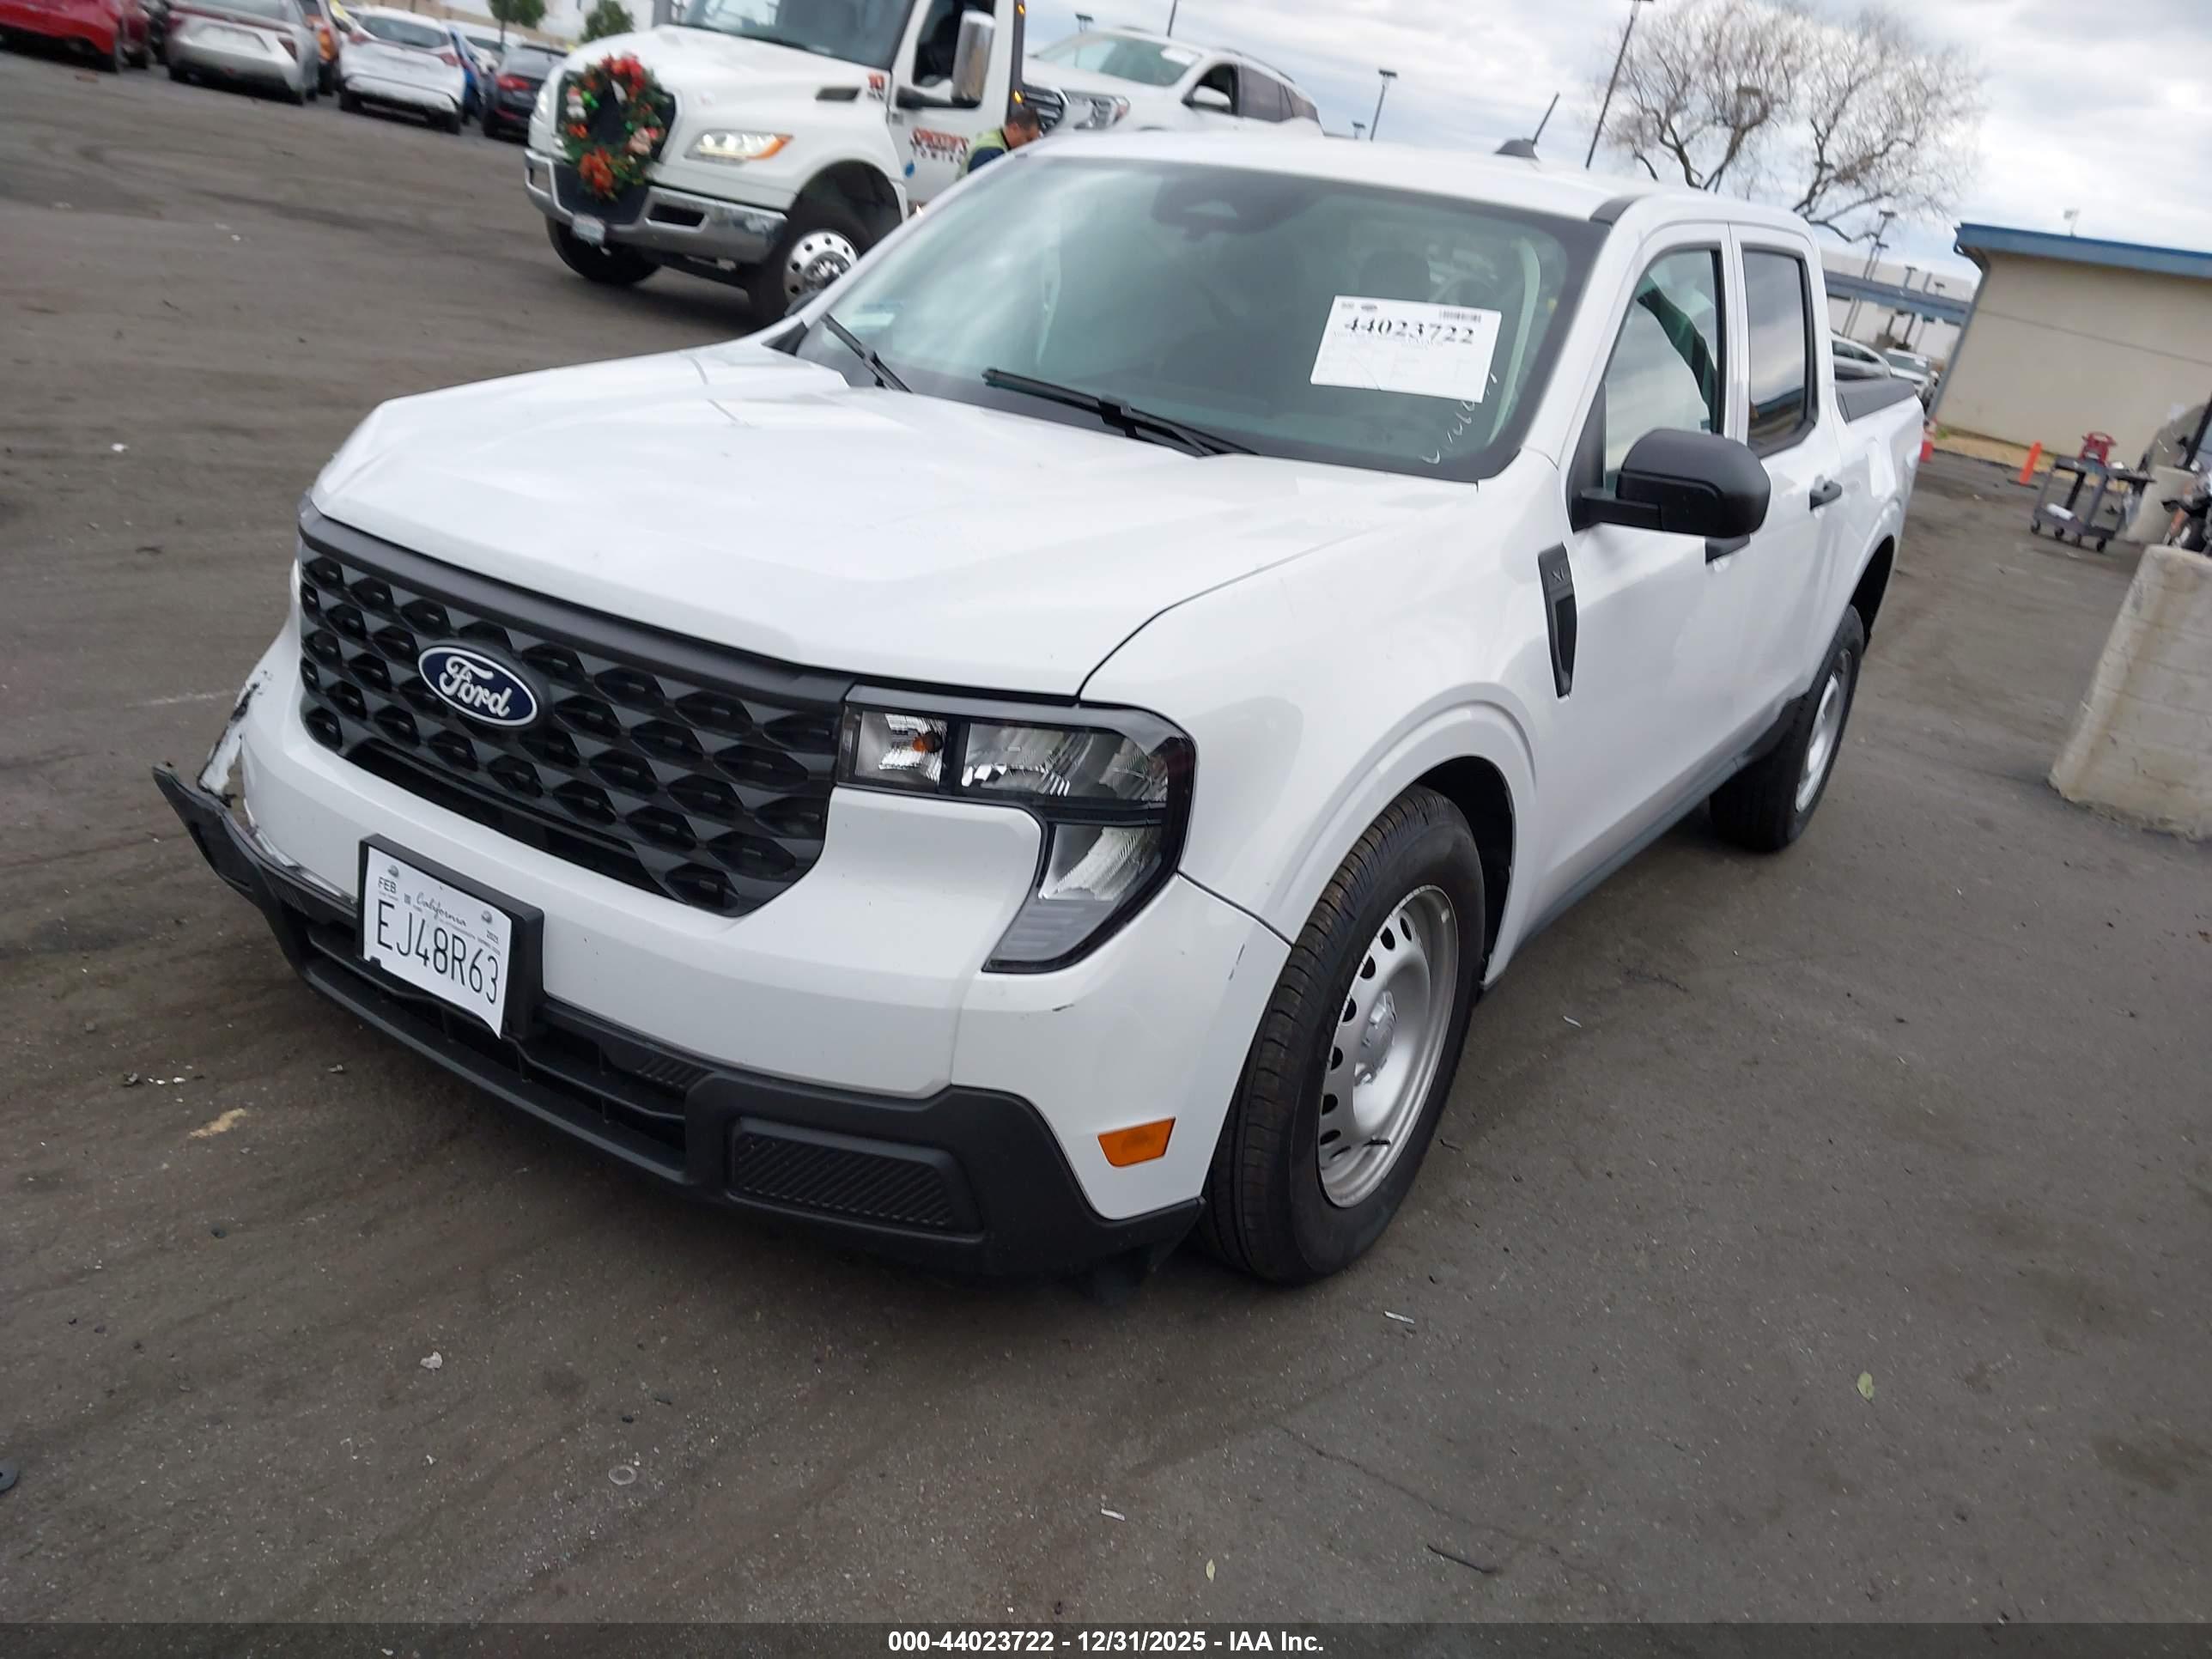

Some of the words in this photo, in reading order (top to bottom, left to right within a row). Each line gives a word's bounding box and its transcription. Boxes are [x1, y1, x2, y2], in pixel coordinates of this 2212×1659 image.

[1345, 317, 1474, 344] 44023722
[439, 655, 512, 717] Ford
[378, 877, 397, 893] FEB
[416, 892, 467, 927] California
[377, 899, 499, 1005] EJ48R63
